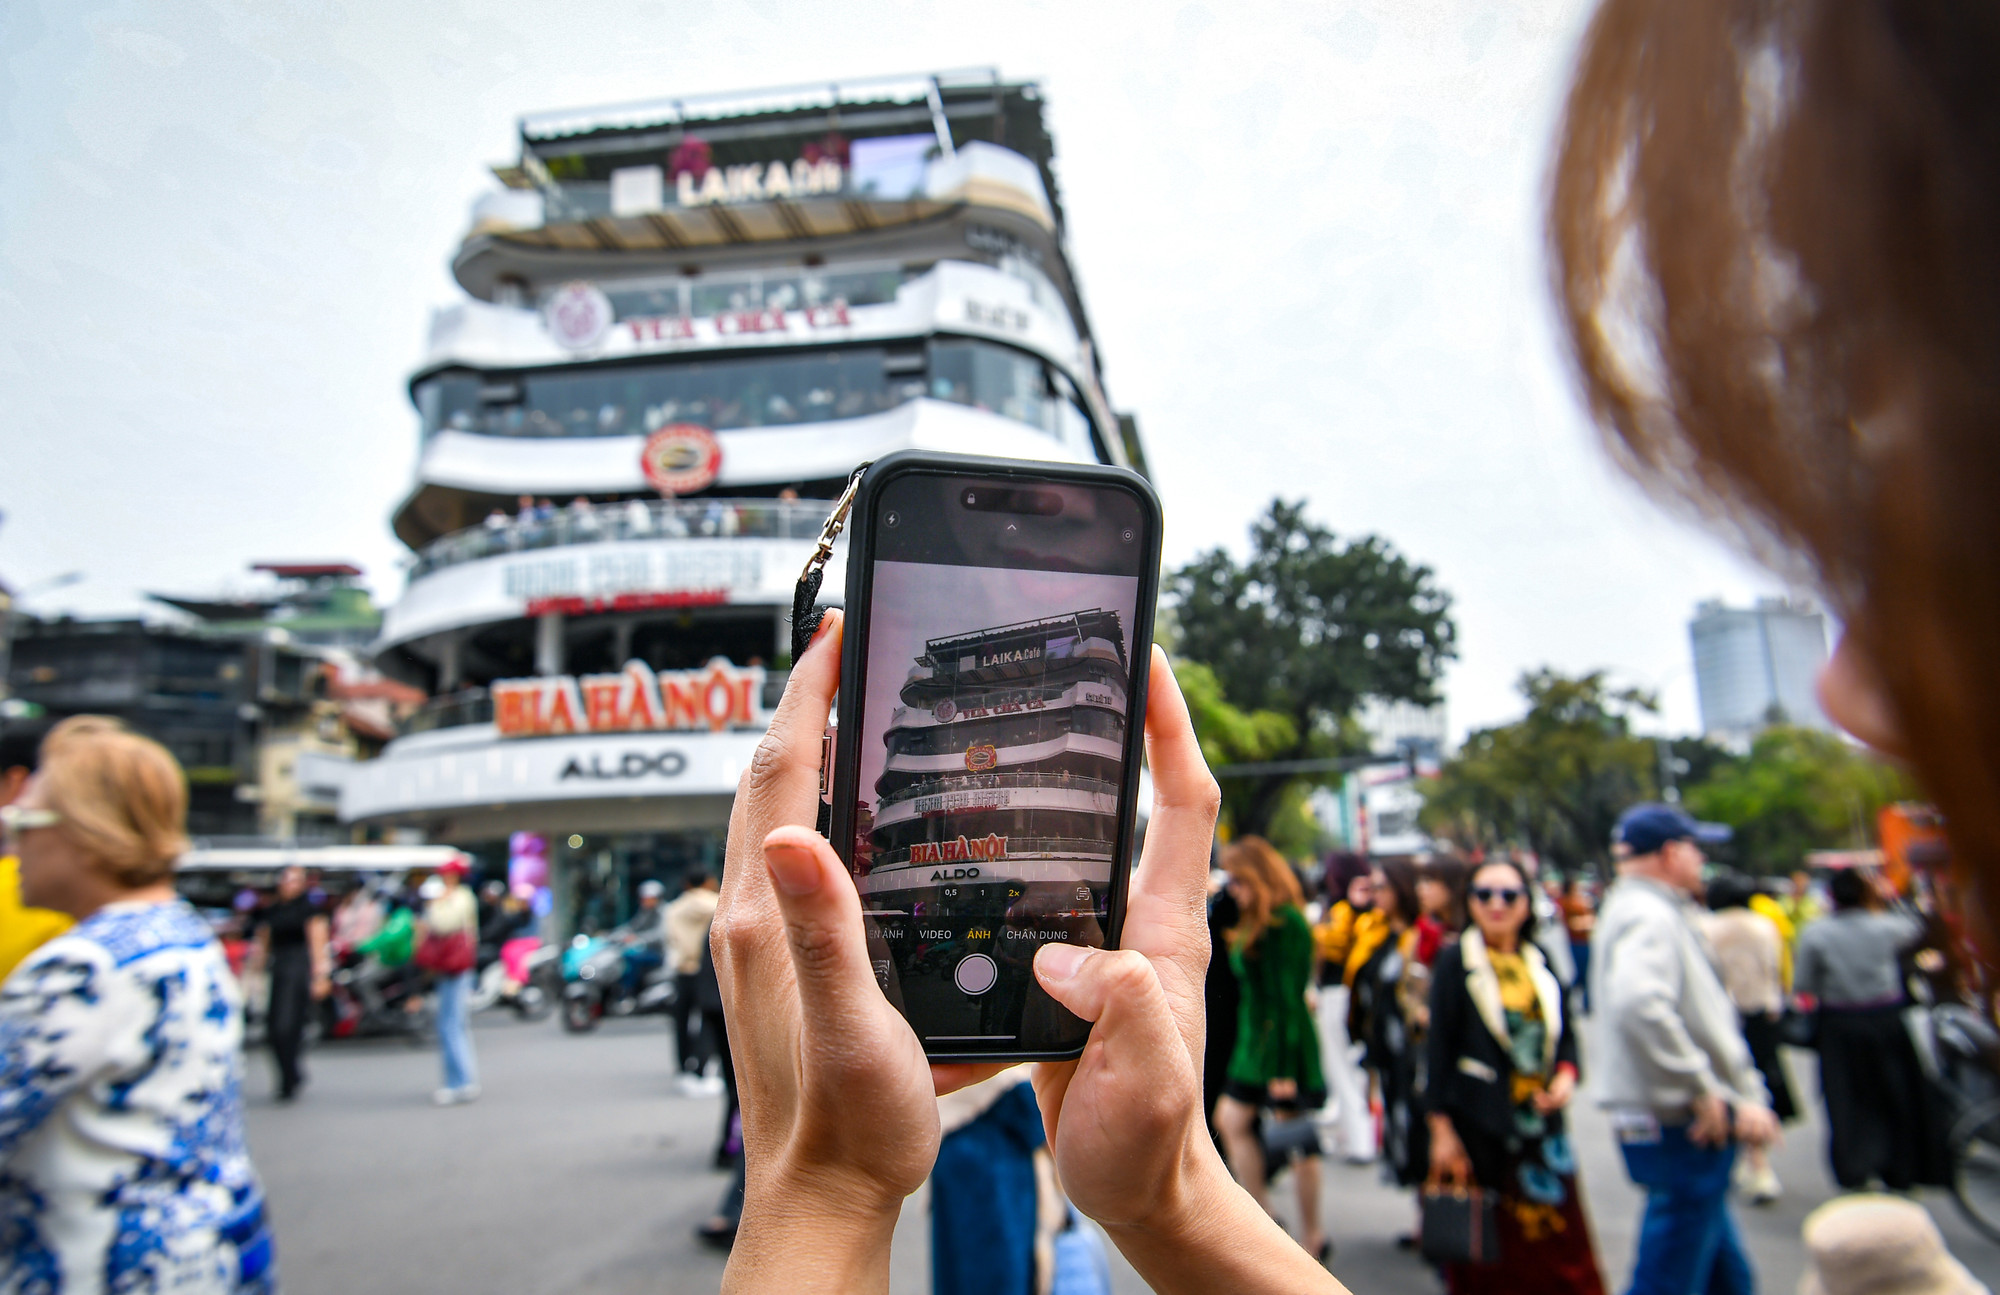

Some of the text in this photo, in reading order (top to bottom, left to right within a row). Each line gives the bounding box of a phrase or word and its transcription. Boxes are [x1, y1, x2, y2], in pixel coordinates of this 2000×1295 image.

[983, 647, 1040, 667] LAIKA Café
[492, 680, 577, 737] BIA
[559, 751, 687, 780] ALDO
[909, 832, 1008, 865] BIA HÀ NỘI
[930, 867, 980, 882] ALDO
[944, 888, 957, 897] 0,5
[1008, 889, 1020, 897] 2x
[919, 930, 952, 939] VIDEO
[967, 927, 991, 940] ẢNH
[1006, 928, 1037, 940] CHÂN
[1039, 930, 1068, 940] DUNG
